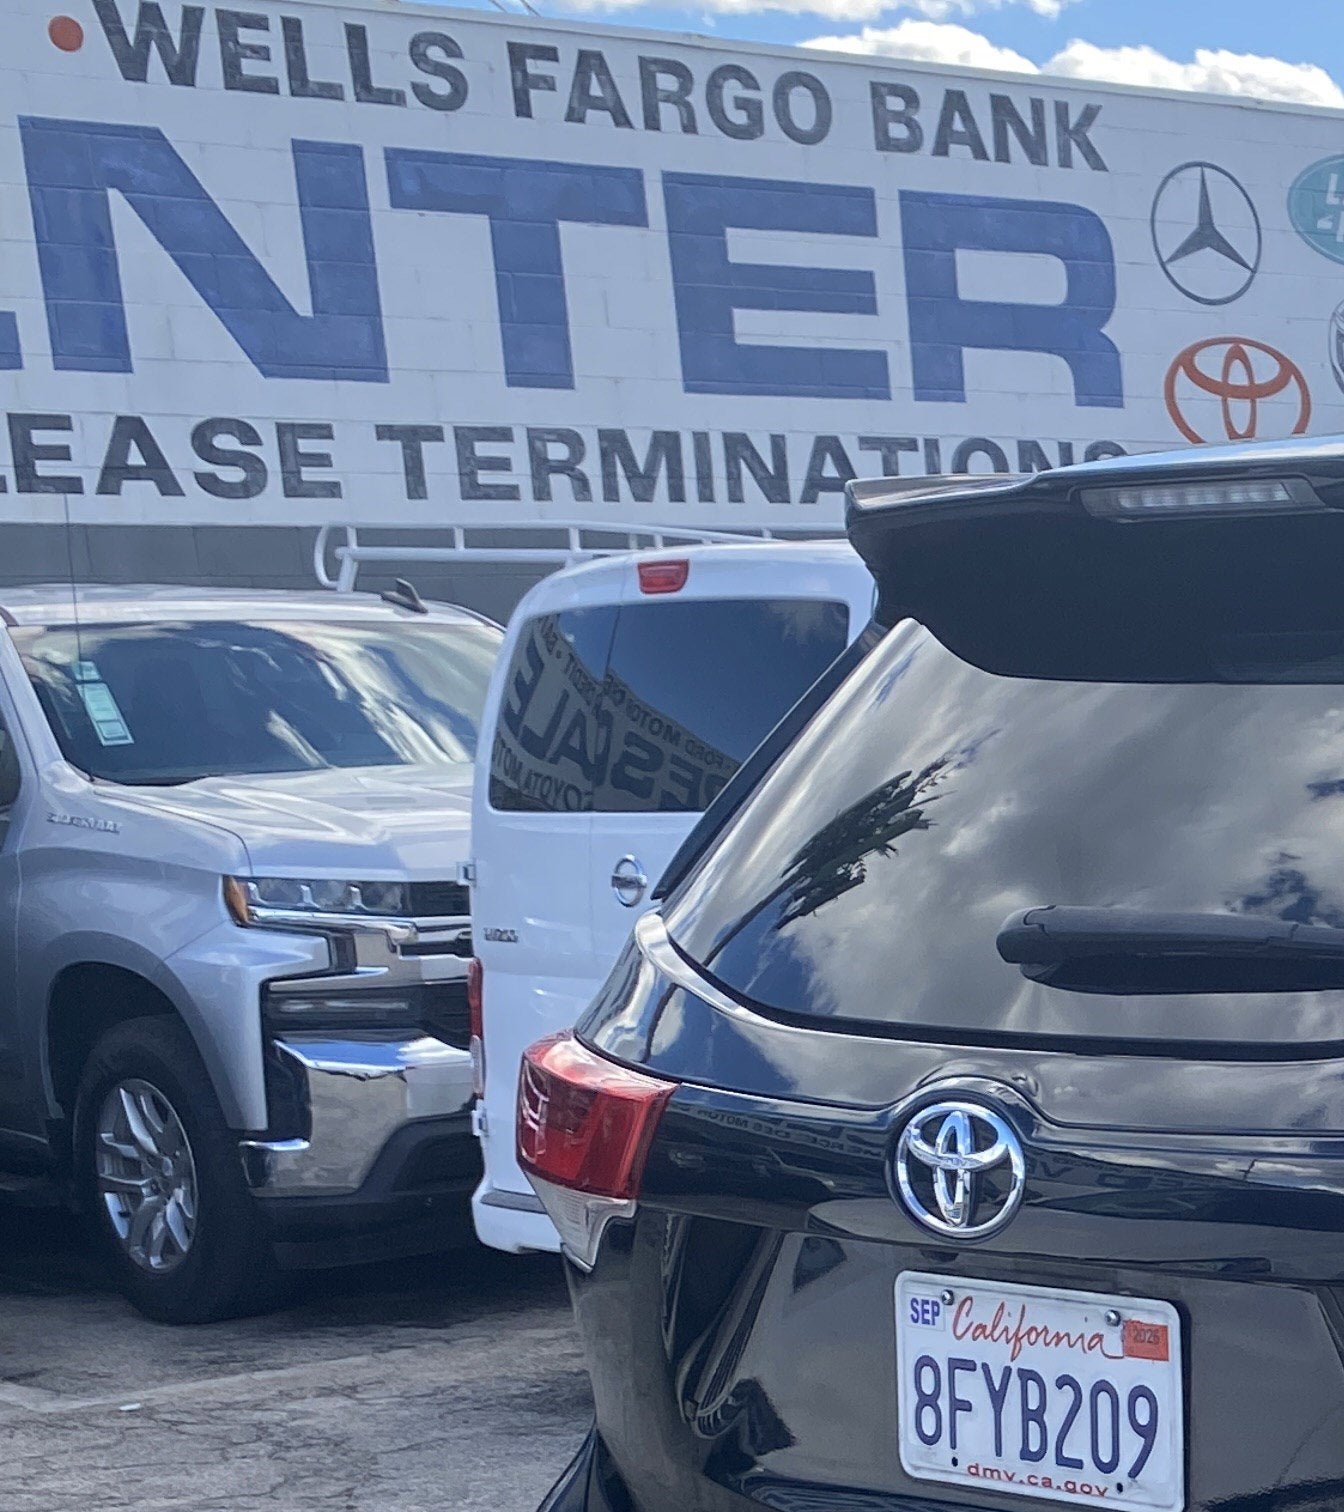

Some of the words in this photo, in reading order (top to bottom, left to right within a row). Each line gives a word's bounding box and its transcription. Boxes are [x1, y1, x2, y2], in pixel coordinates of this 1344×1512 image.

[92, 0, 469, 112] WELLS
[506, 40, 832, 145] FARGO
[869, 80, 1109, 172] BANK
[0, 115, 1124, 408] NTER
[0, 412, 343, 499] EASE
[910, 1297, 940, 1326] SEP
[952, 1295, 1124, 1362] California
[913, 1354, 1159, 1479] 8FYB209
[967, 1462, 1109, 1498] dmv.ca.gov
